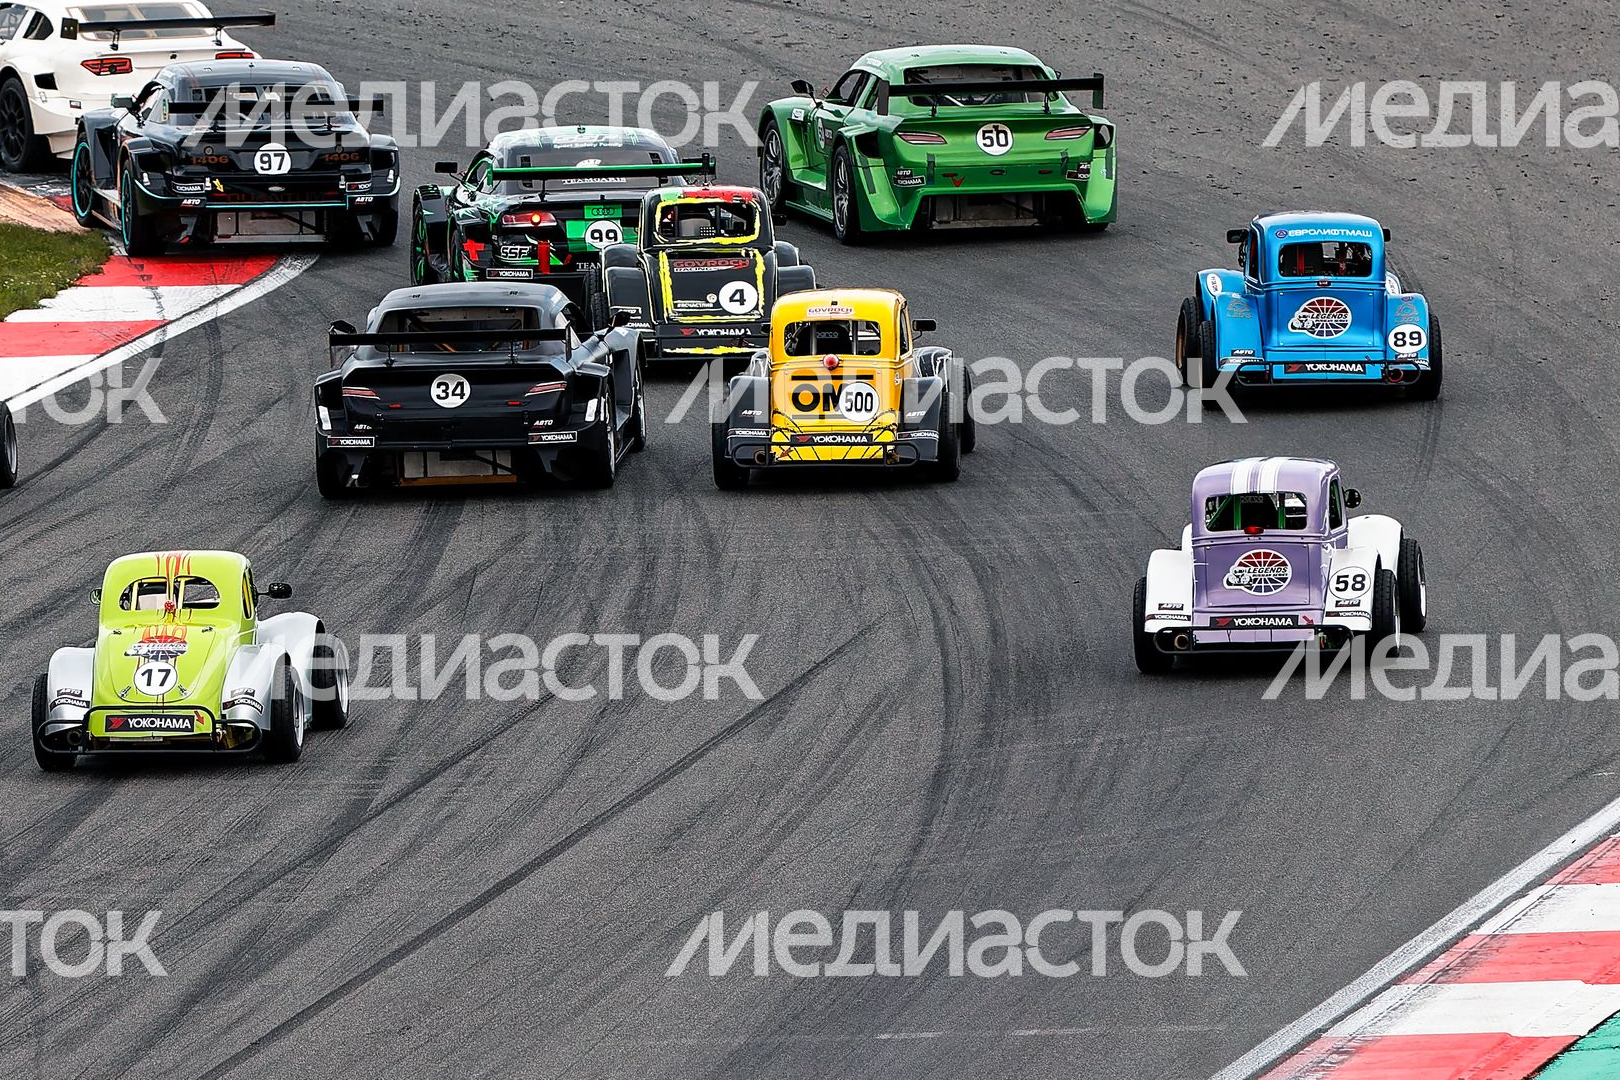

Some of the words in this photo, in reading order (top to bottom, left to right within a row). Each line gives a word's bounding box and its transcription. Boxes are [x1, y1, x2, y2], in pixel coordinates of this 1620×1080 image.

[982, 129, 1009, 147] 50
[190, 155, 229, 165] 1406
[260, 153, 285, 171] 97
[323, 153, 360, 162] 1406
[590, 228, 618, 242] 99
[1288, 228, 1372, 237] ЕВРОЛИФТМАШ
[500, 245, 531, 260] SSF
[728, 288, 747, 306] 4
[696, 328, 752, 336] YOKOHAMA
[1393, 331, 1422, 347] 89
[1305, 363, 1364, 373] YOKOHAMA
[435, 381, 466, 400] 34
[844, 391, 874, 413] 500
[541, 433, 573, 441] YOKOHAMA
[813, 435, 868, 444] YOKOHAMA
[1335, 574, 1366, 592] 58
[1234, 617, 1293, 627] YOKOHAMA
[140, 668, 172, 687] 17
[54, 698, 87, 707] YOKOHAMA
[234, 699, 262, 712] YOKOHAMA
[127, 718, 192, 730] YOKOHAMA
